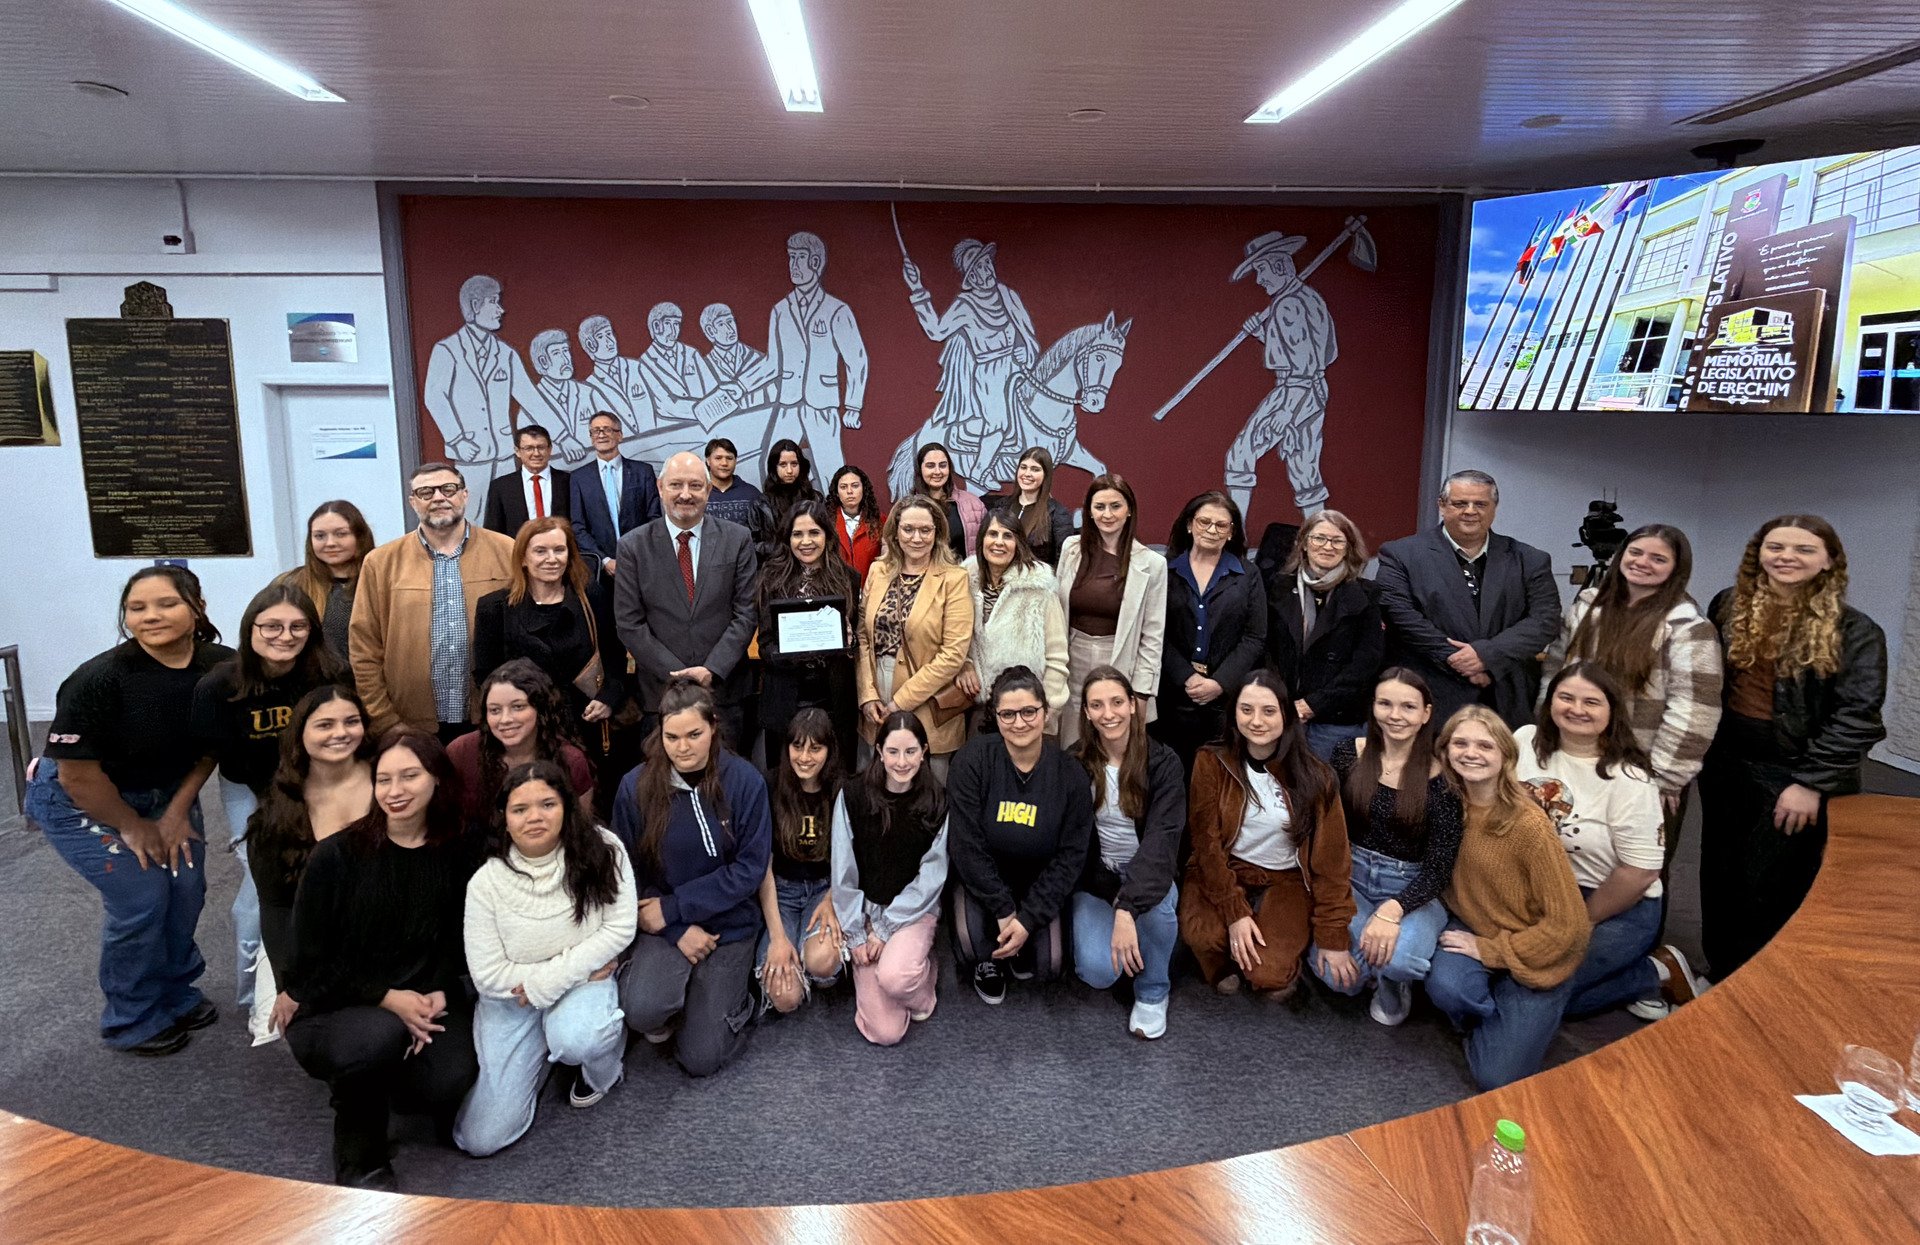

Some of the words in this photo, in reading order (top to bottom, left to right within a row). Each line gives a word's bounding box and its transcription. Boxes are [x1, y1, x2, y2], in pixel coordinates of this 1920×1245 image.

[1703, 352, 1797, 367] MEMORIAL
[1700, 367, 1796, 381] LEGISLATIVO
[1697, 381, 1718, 394] DE
[1718, 382, 1790, 397] ERECHIM
[997, 801, 1037, 827] HIGH
